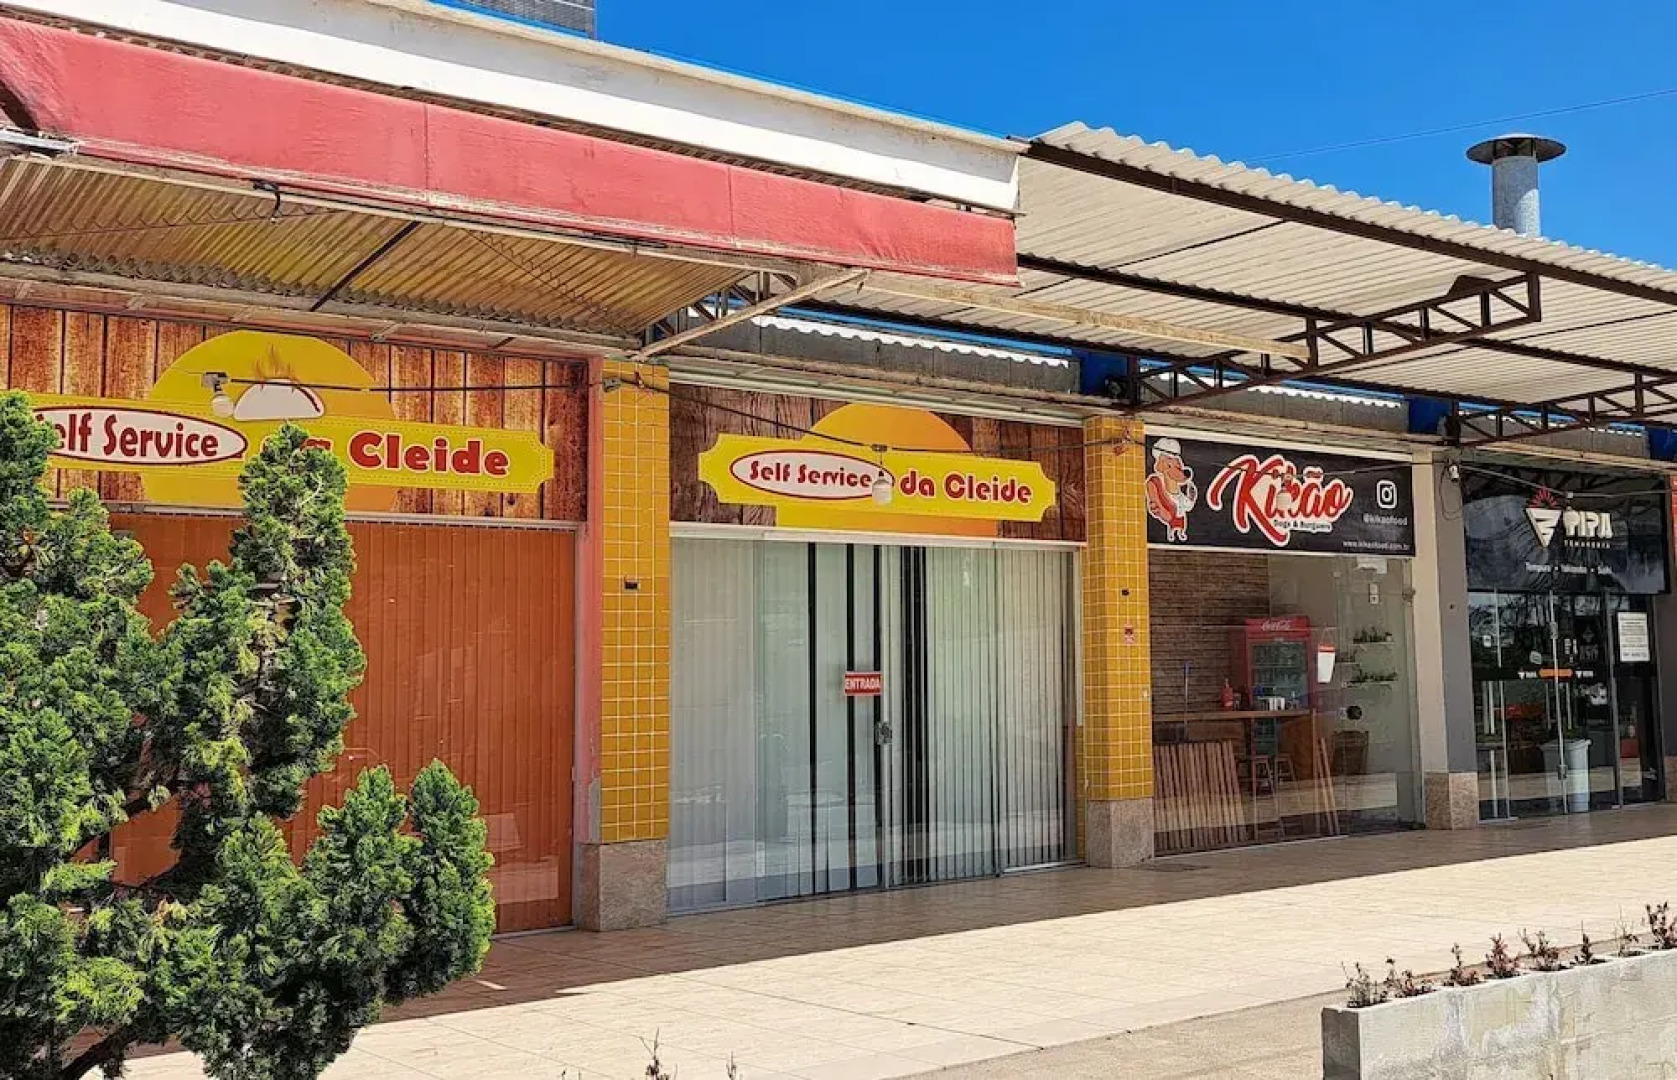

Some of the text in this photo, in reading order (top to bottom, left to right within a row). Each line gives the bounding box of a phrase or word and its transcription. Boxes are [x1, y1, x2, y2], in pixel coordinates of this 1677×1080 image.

[36, 412, 219, 458] elf Service
[350, 432, 509, 476] Cleide
[750, 460, 873, 487] Self Service
[900, 470, 1032, 504] da Cleide
[844, 676, 882, 690] ENTRADA
